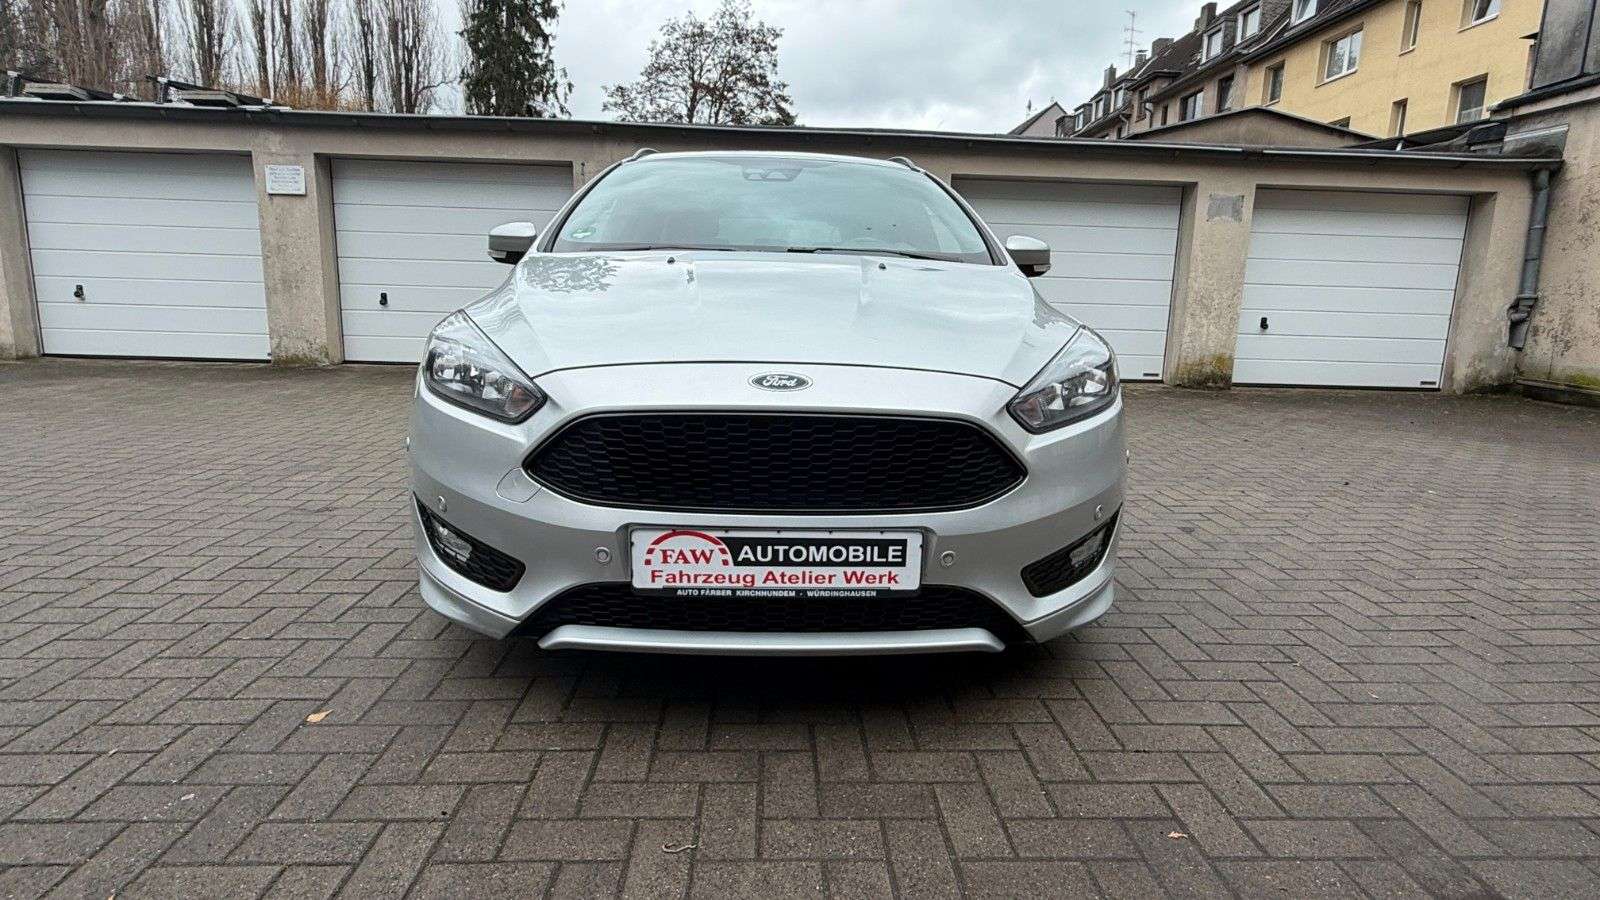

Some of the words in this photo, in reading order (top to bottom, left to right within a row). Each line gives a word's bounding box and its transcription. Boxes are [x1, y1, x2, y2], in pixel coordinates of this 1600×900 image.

[762, 375, 797, 386] Ford
[660, 549, 714, 565] FAW
[737, 545, 903, 562] AUTOMOBILE
[650, 569, 756, 587] Fahrzeug
[762, 570, 837, 584] Atelier
[843, 570, 899, 584] Werk
[807, 589, 877, 597] WÜRDINGHAUSEN
